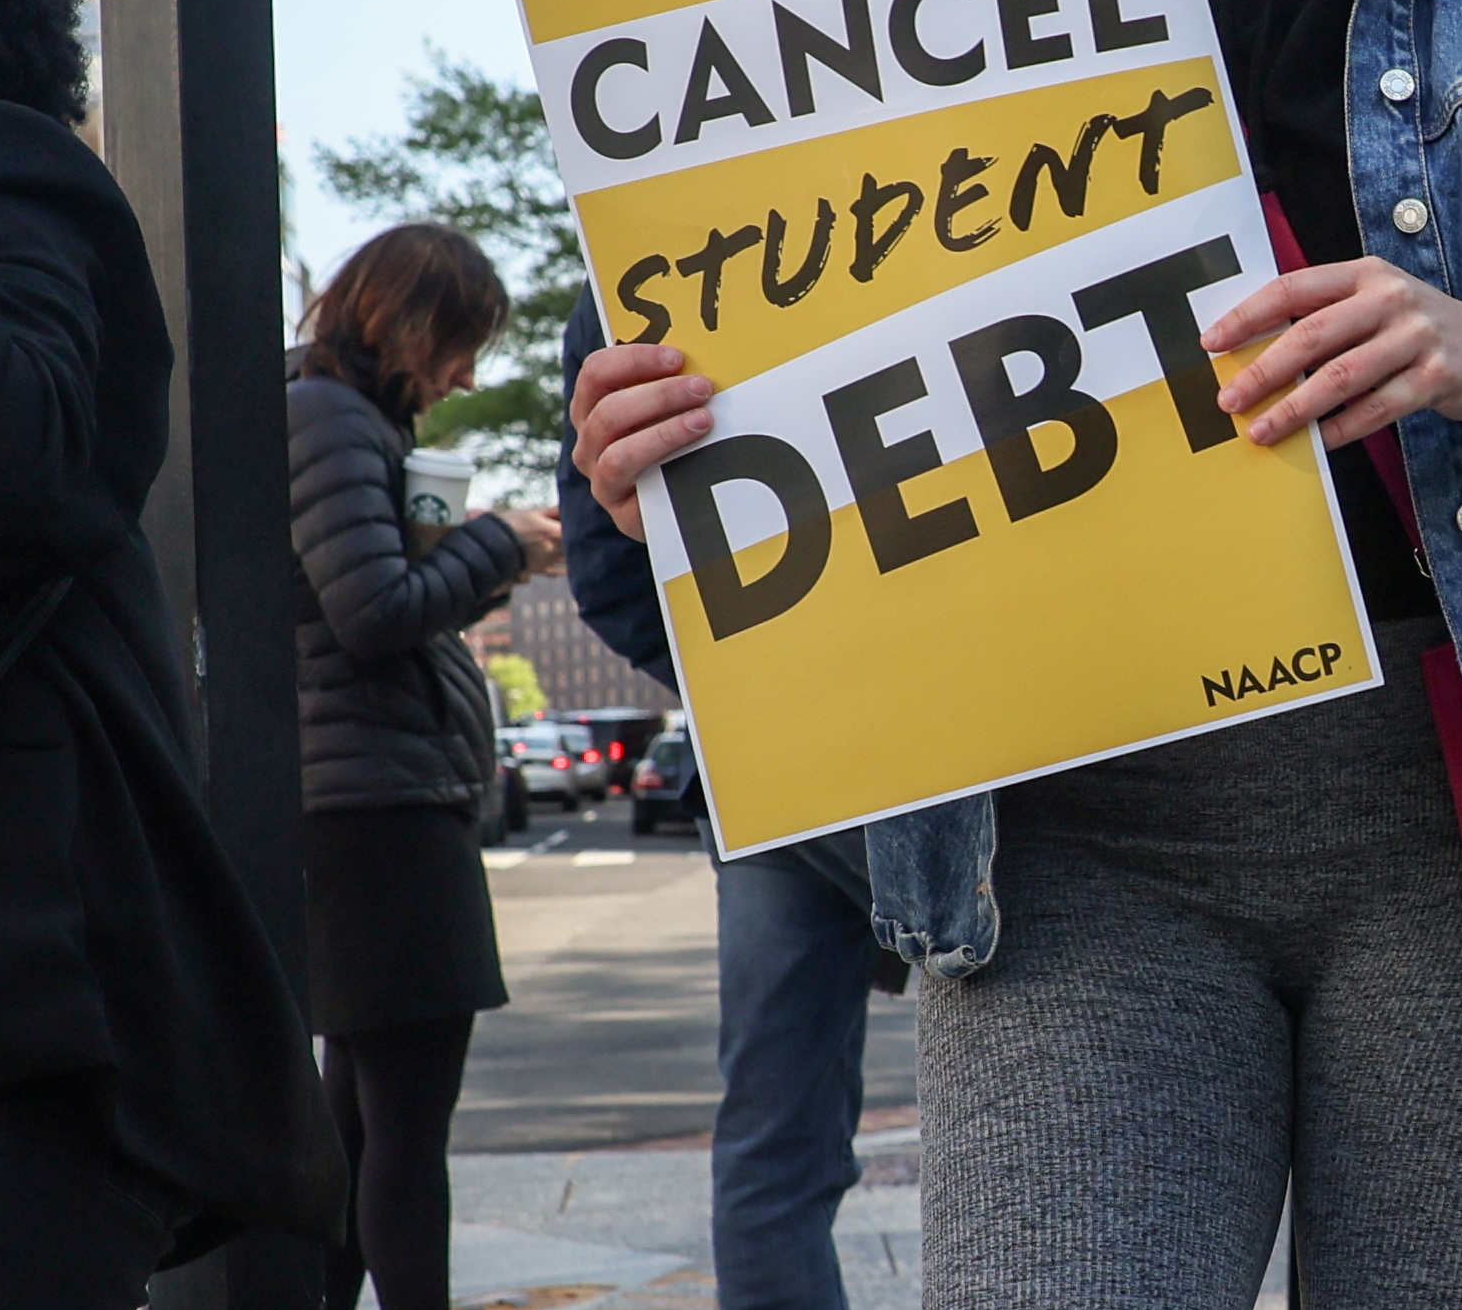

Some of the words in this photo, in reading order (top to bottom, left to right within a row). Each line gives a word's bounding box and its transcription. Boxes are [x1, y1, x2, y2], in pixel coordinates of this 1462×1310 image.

[616, 88, 1215, 347] STUDENT
[660, 234, 1246, 643] DEBT
[1201, 642, 1343, 708] NAACP
